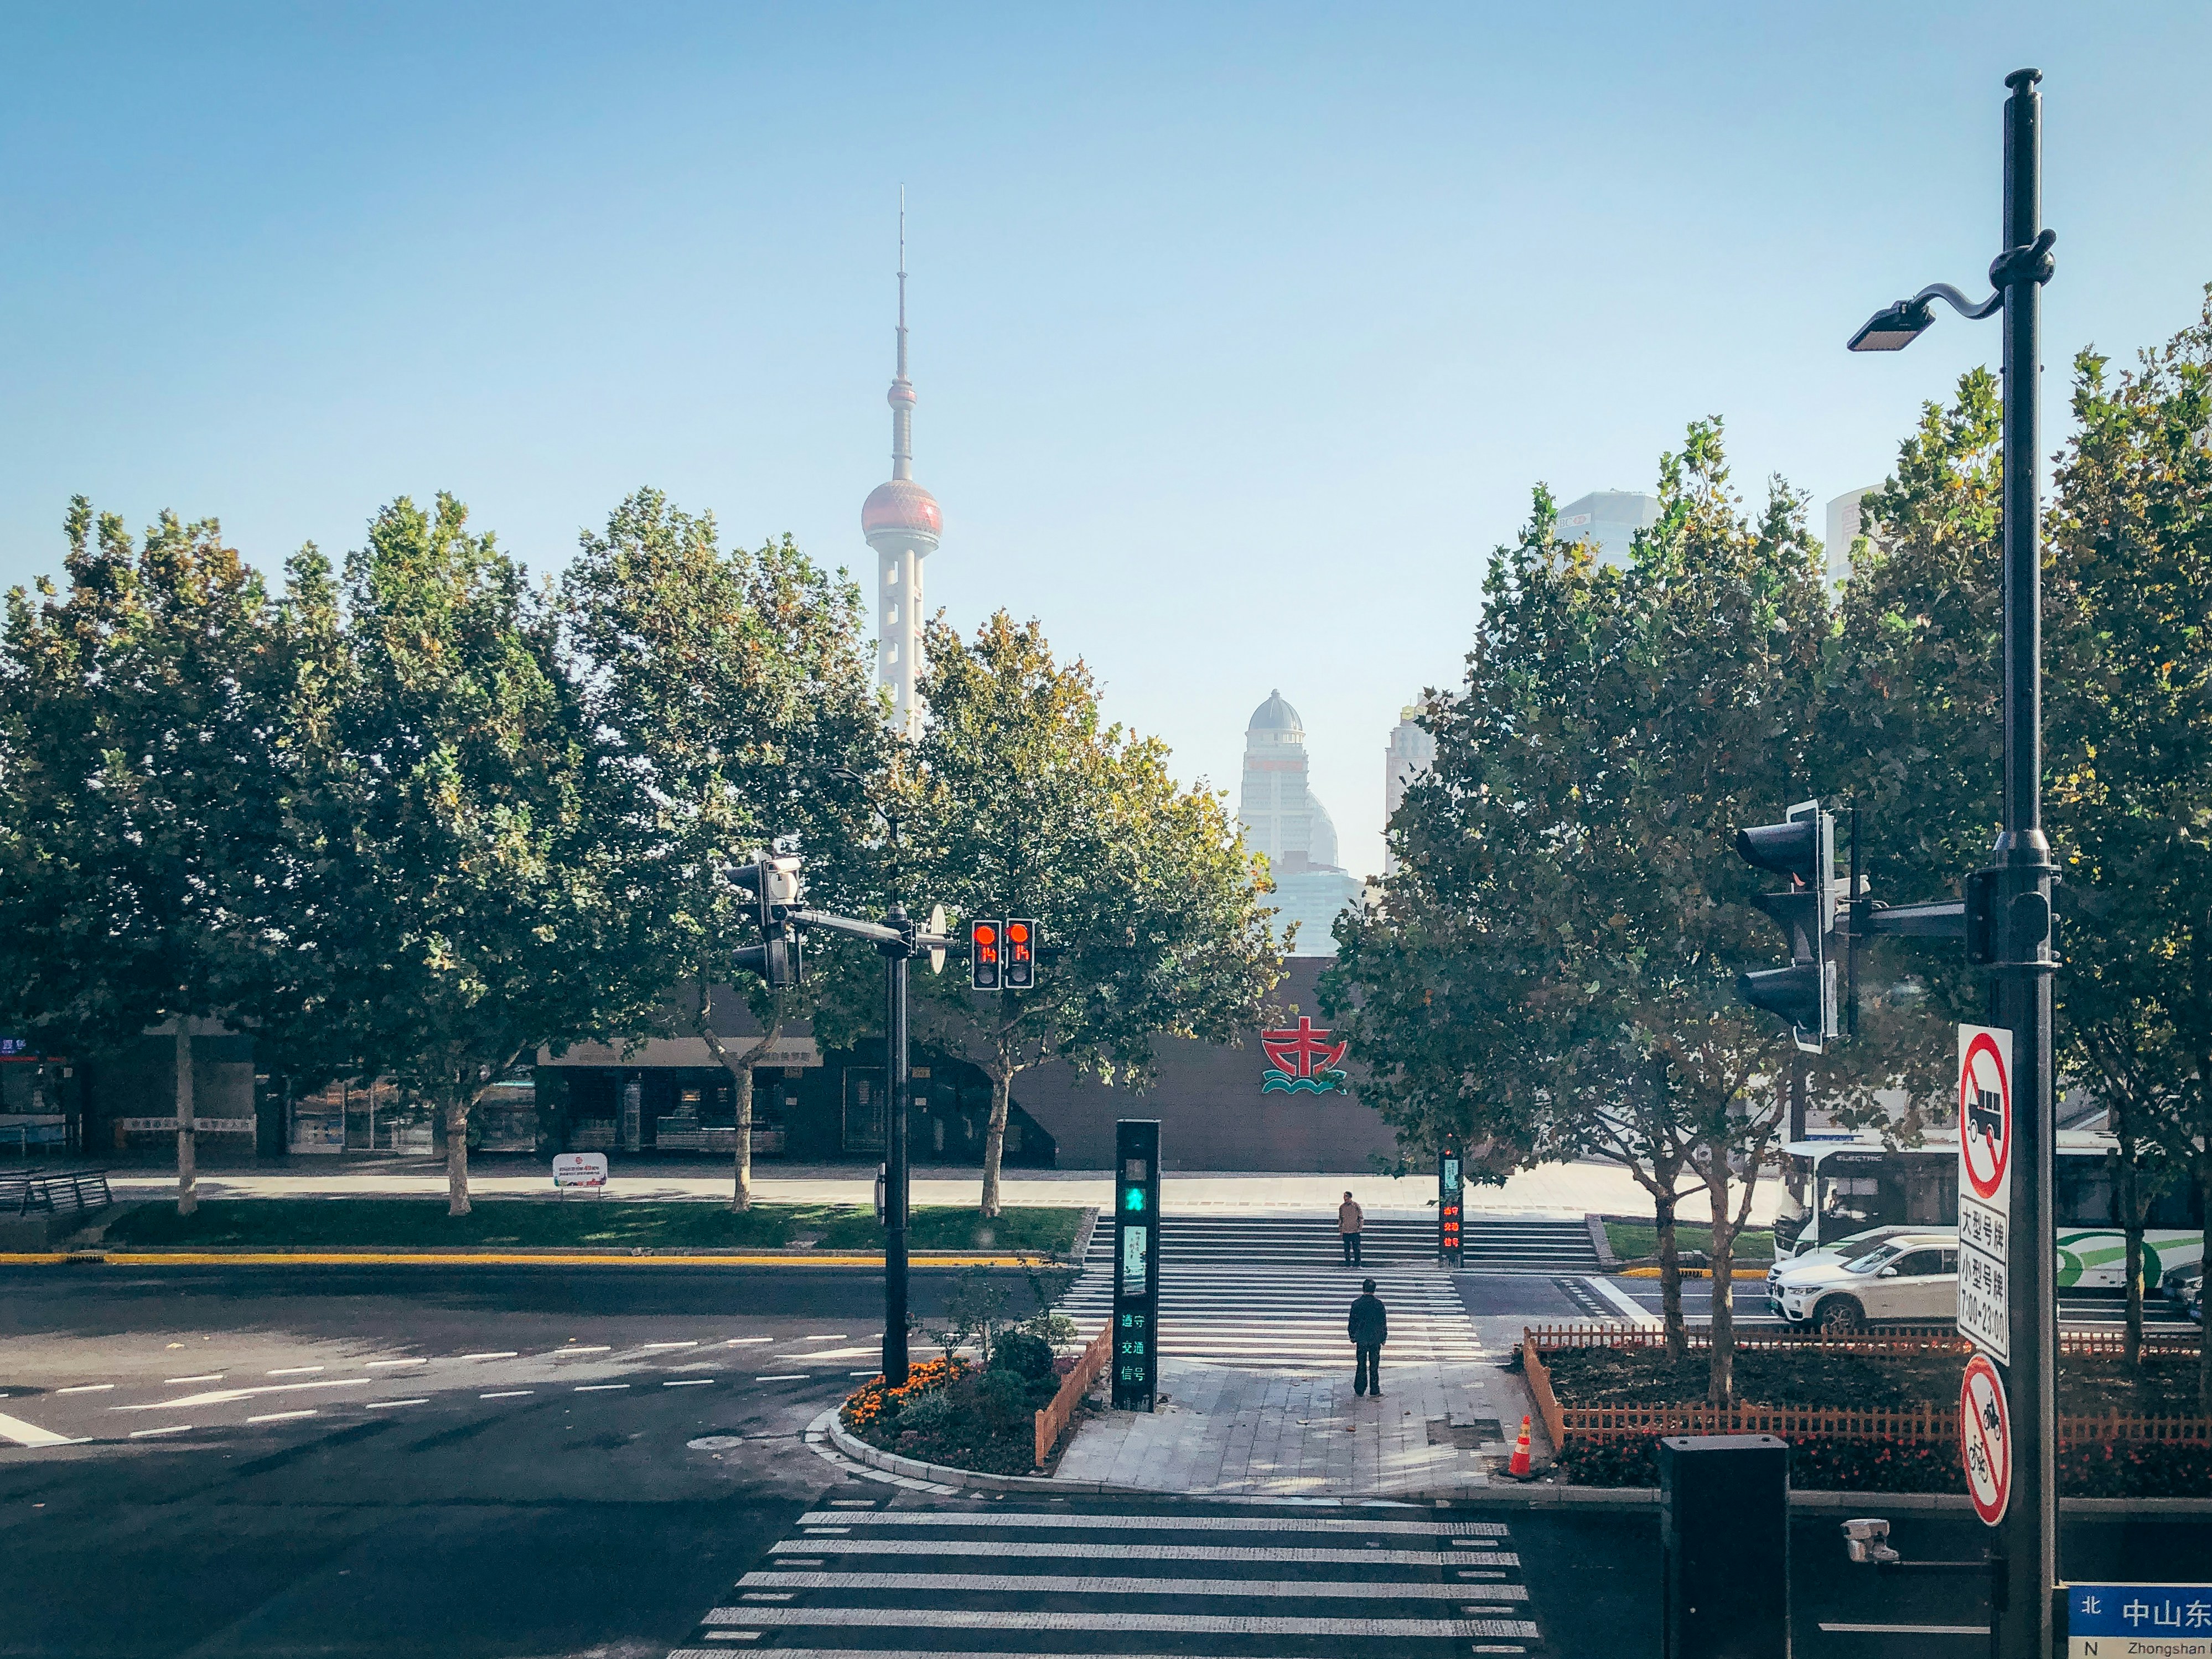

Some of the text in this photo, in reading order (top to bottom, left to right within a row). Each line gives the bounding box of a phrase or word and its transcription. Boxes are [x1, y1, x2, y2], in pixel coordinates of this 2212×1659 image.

[1962, 1206, 2004, 1253] 大型号牌
[1962, 1253, 2003, 1303] 小型号牌
[1962, 1289, 2004, 1344] 7:00-23:00
[1122, 1340, 1144, 1354] 交通
[1121, 1366, 1145, 1381] 信号
[2081, 1595, 2212, 1628] 北 中山东
[2085, 1641, 2098, 1656] N
[2128, 1642, 2205, 1657] Zhongshan
